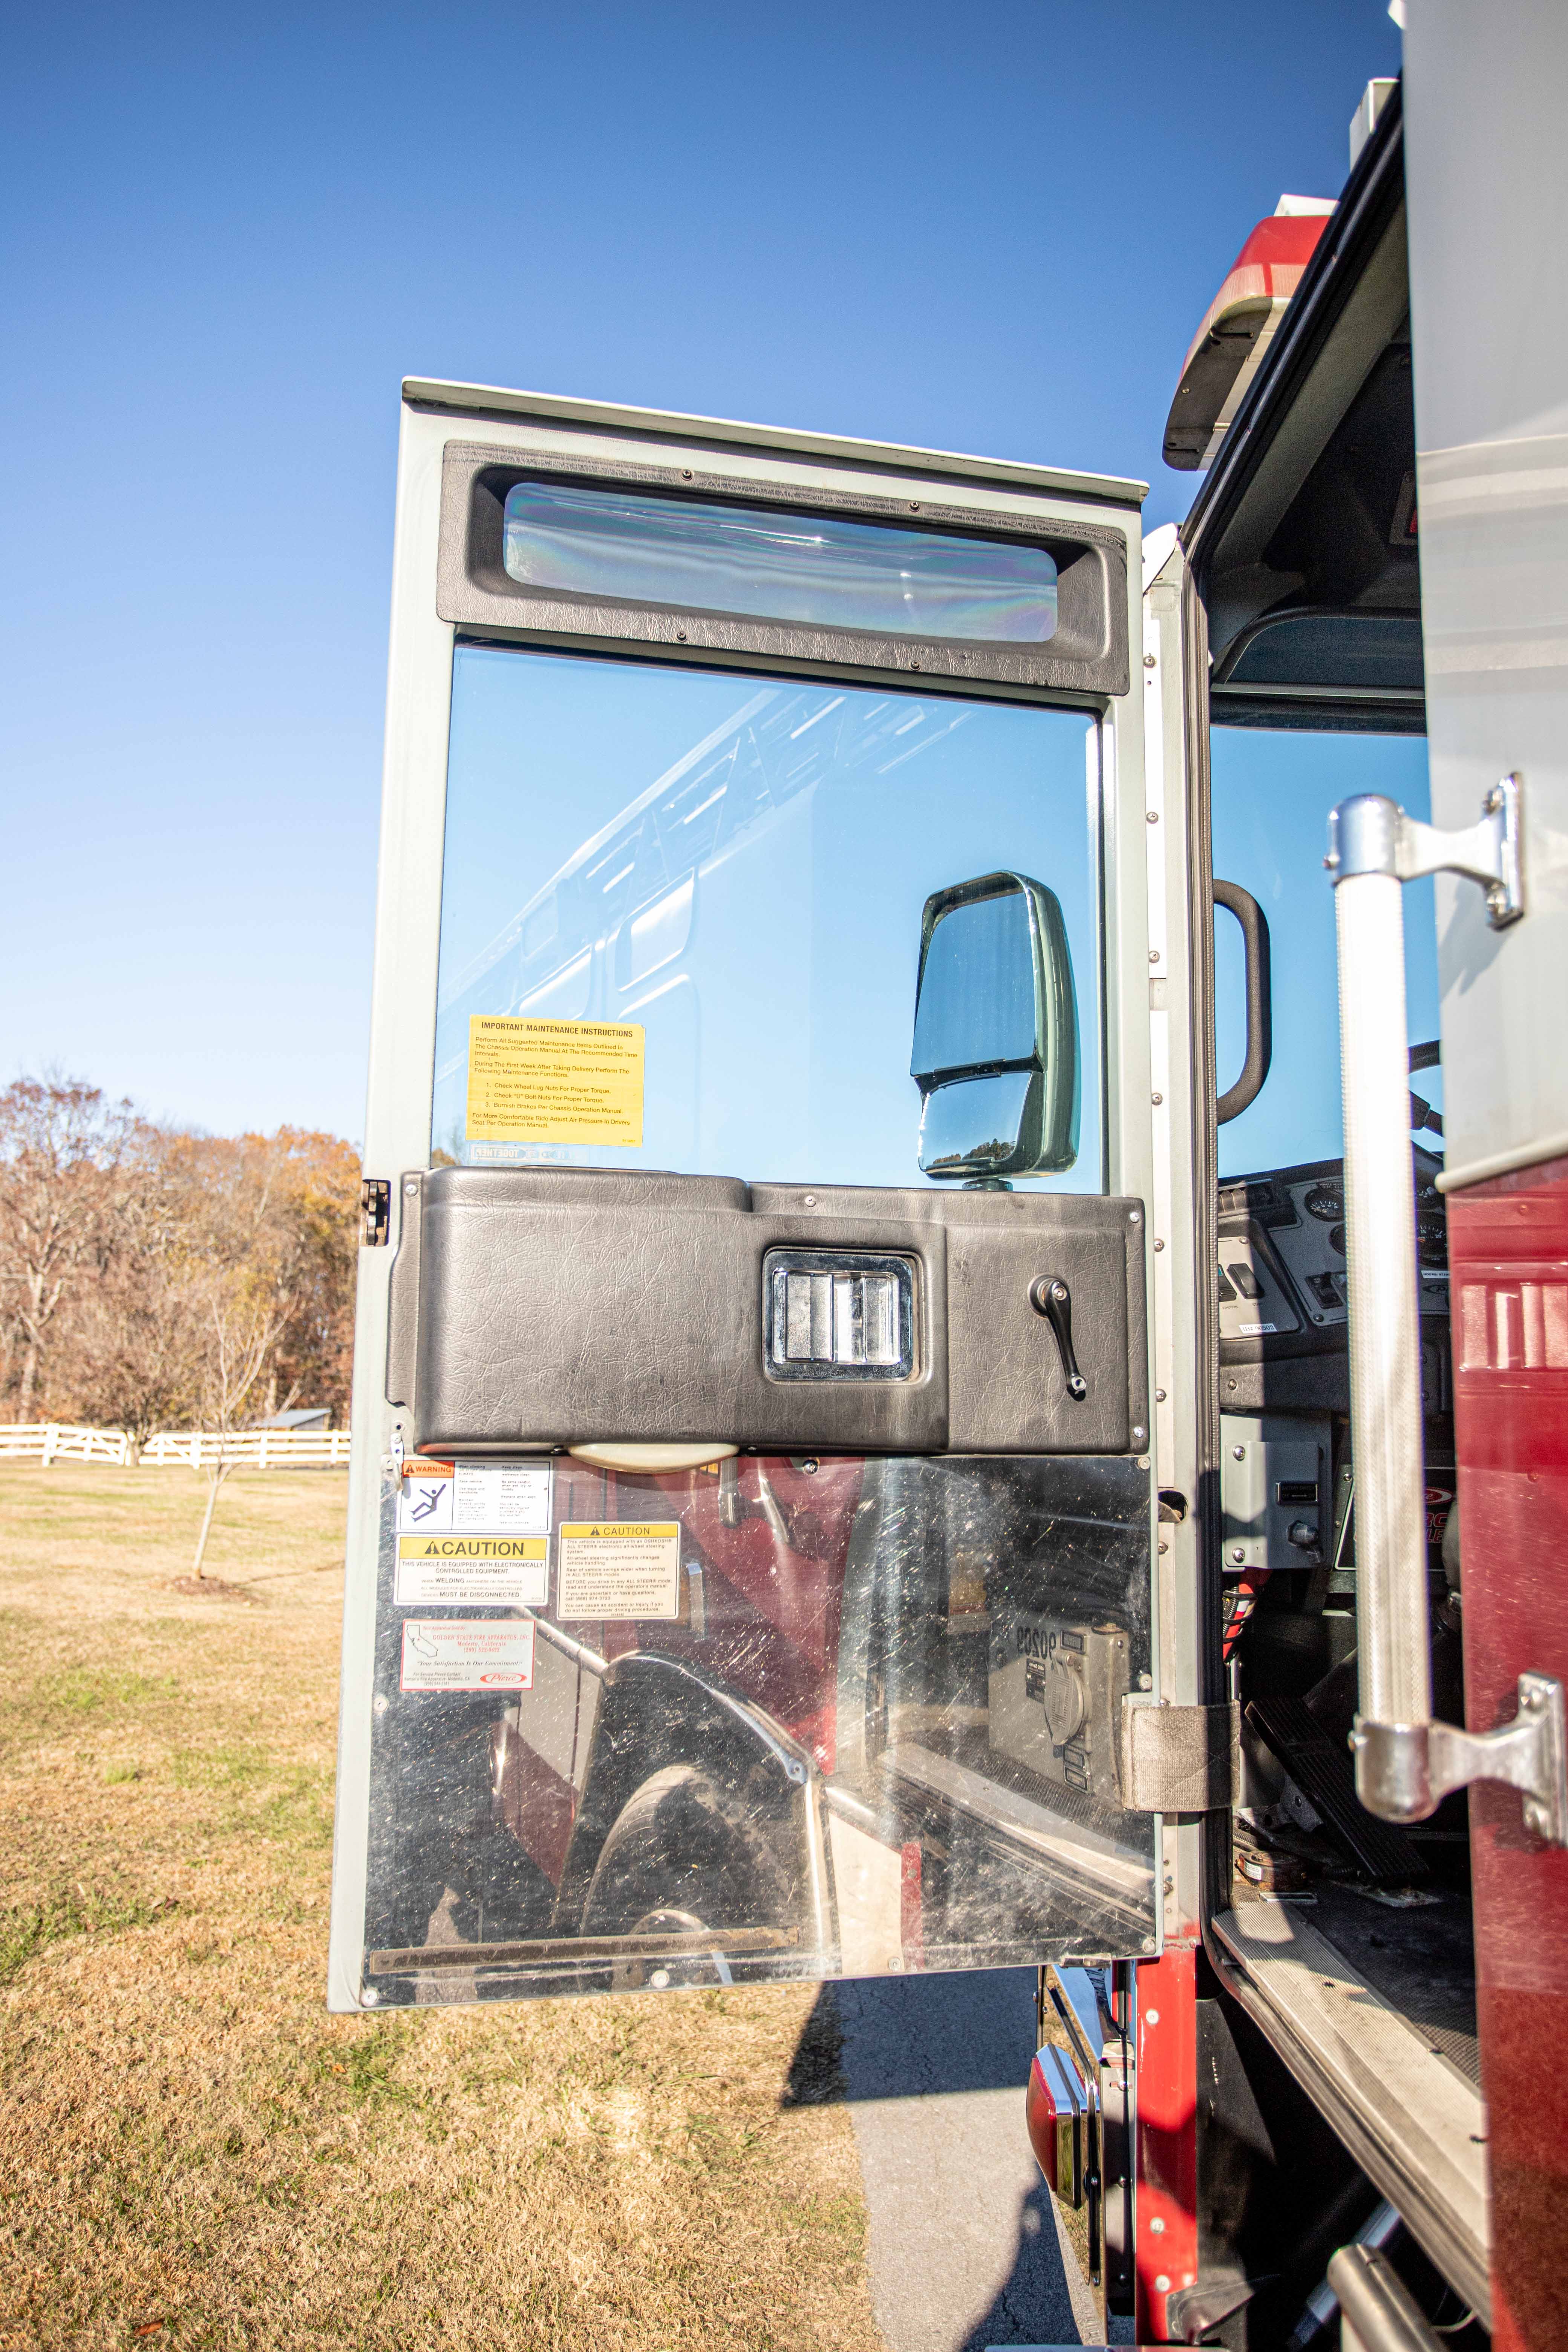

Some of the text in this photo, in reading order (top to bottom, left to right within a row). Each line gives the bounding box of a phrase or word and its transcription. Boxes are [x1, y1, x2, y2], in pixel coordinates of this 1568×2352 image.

[481, 1022, 632, 1037] IMPORTANT MAINTENANCE INSTRUCTIONS
[442, 1542, 524, 1556] CAUTION
[490, 1674, 516, 1682] Pierce
